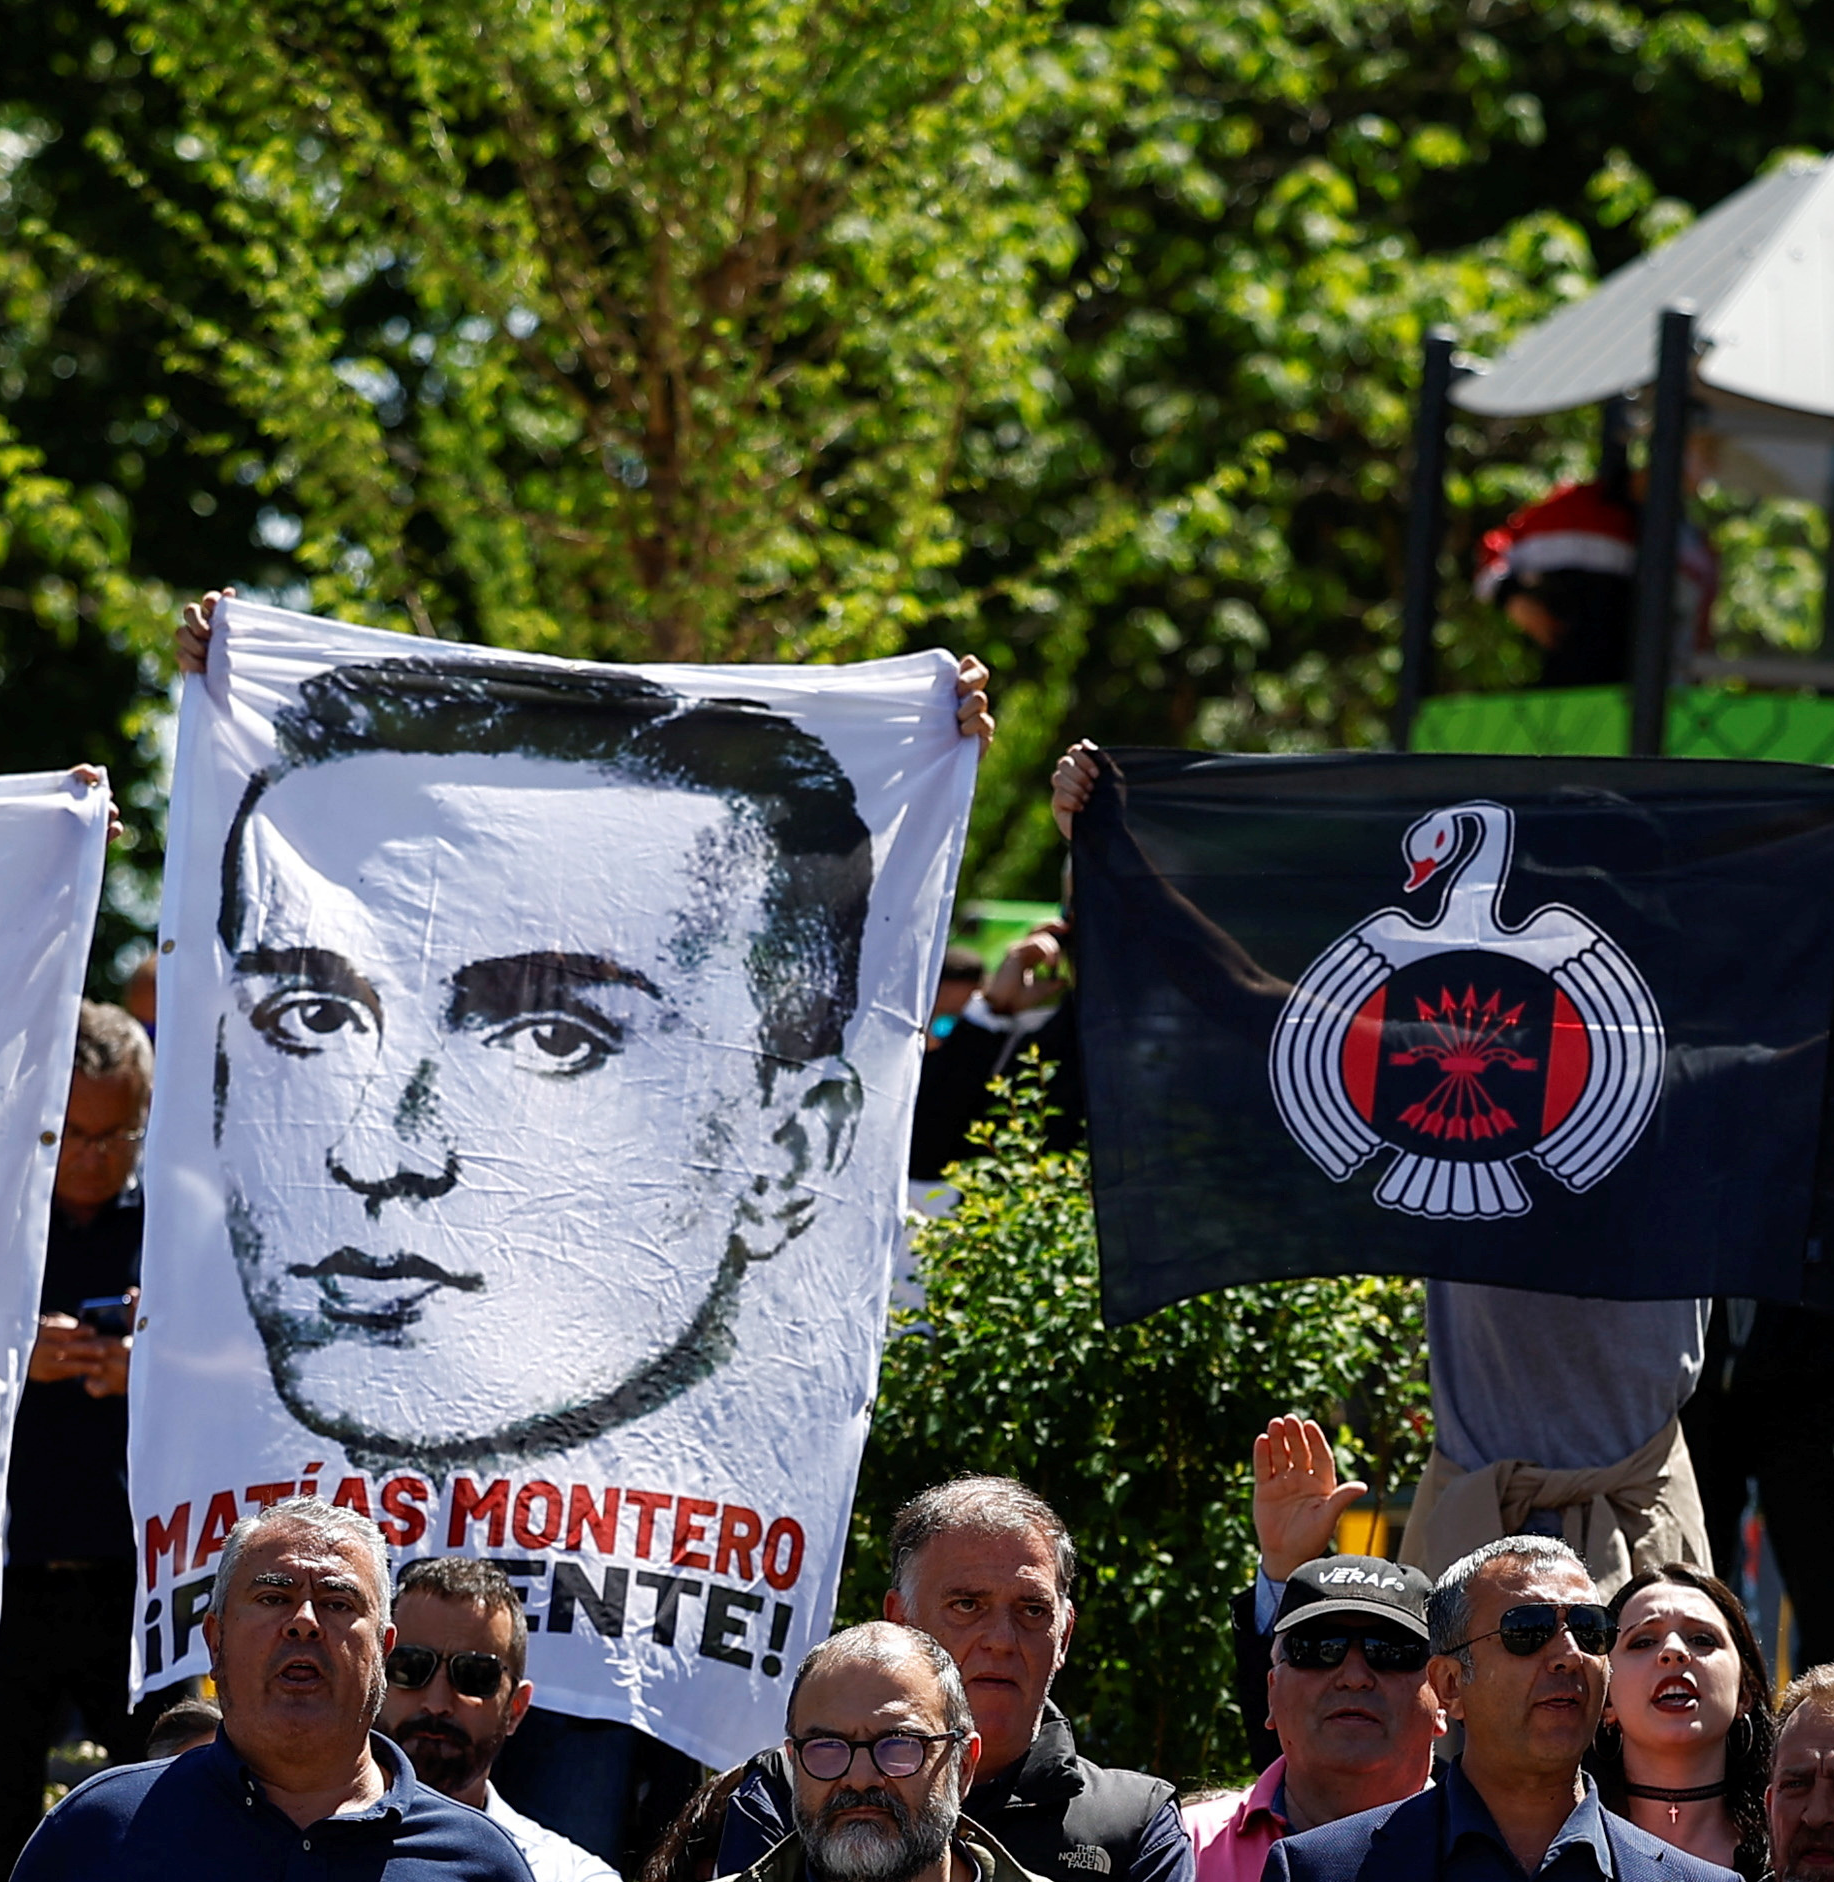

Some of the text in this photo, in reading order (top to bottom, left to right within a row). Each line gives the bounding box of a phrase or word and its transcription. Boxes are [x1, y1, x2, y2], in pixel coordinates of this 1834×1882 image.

[446, 1478, 805, 1592] MONTERO
[1075, 1844, 1096, 1854] THE
[1058, 1851, 1095, 1863] NORTH
[1067, 1859, 1093, 1870] FACE
